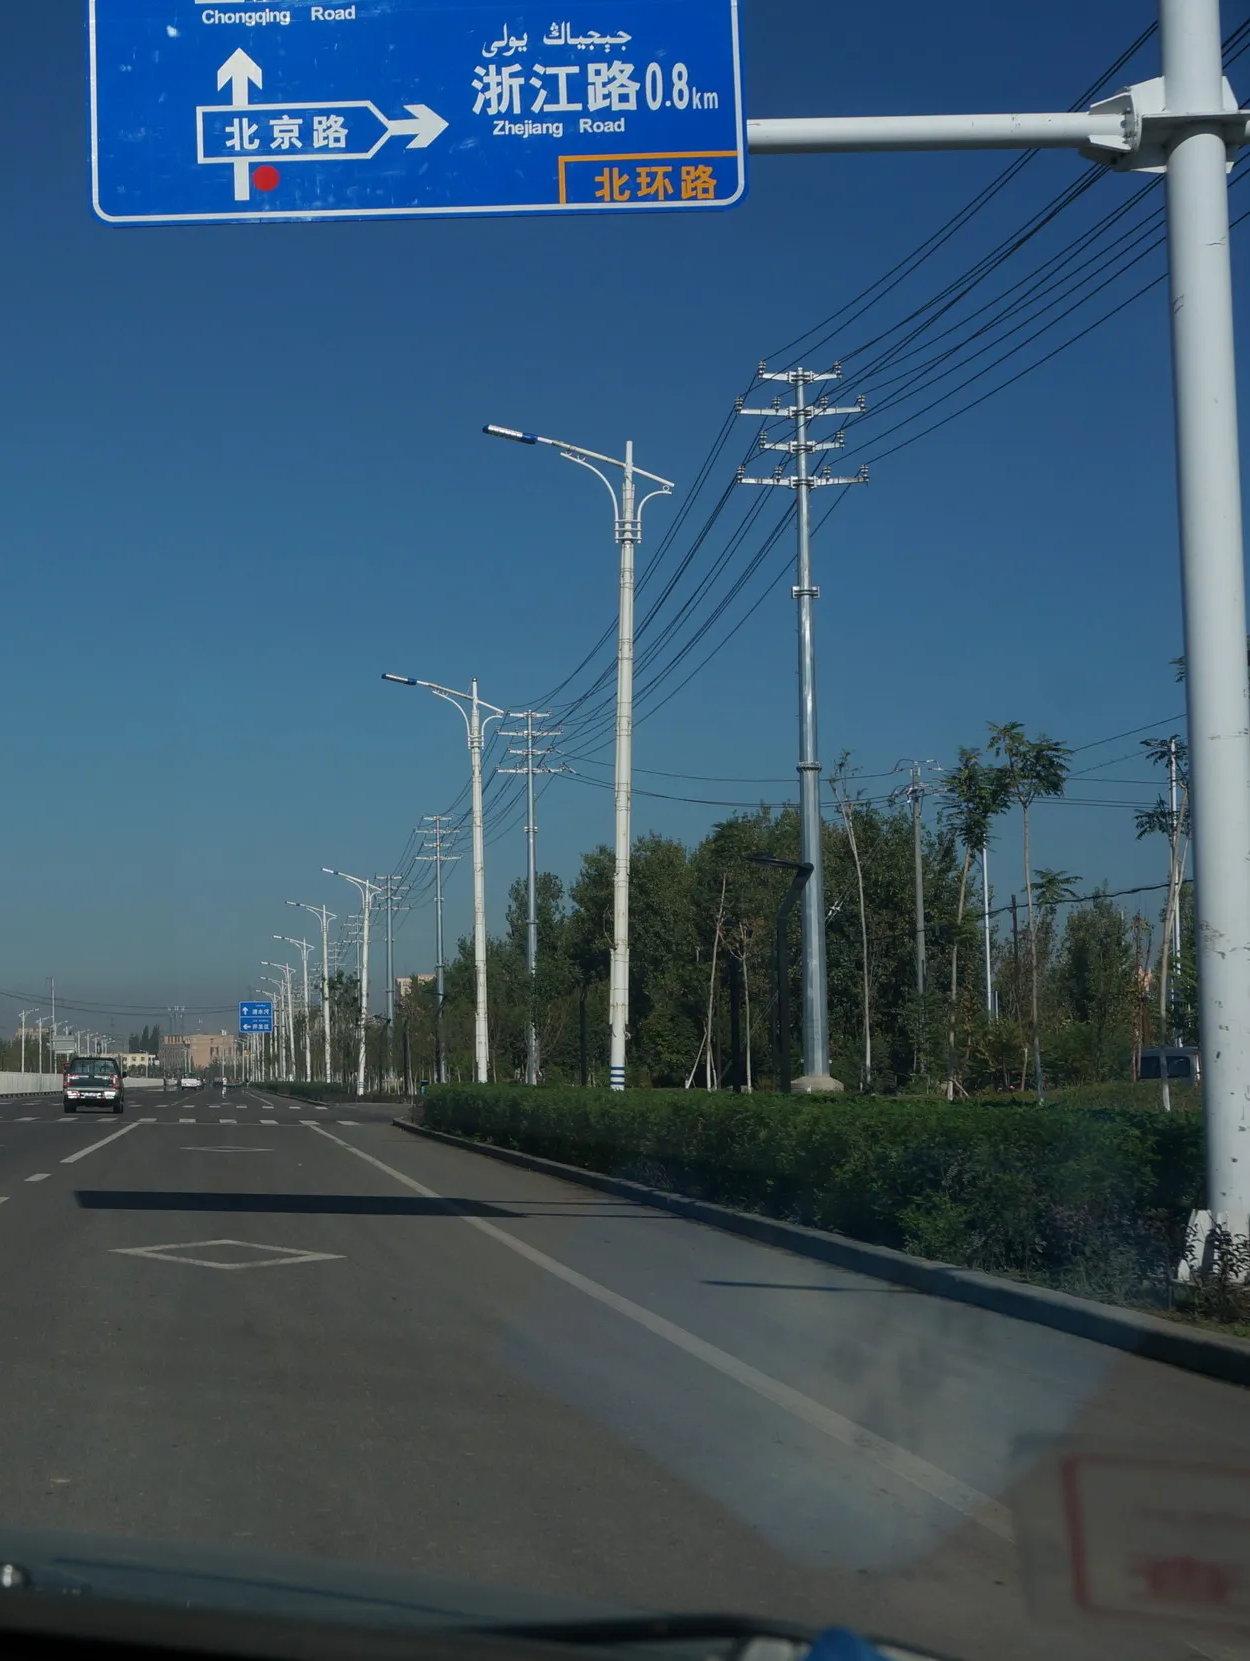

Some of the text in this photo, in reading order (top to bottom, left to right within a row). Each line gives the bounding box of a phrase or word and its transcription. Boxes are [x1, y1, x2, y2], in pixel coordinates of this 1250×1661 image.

[203, 7, 356, 27] Chongqing Road
[473, 62, 641, 115] 浙江路
[227, 116, 349, 151] 北京路
[494, 119, 625, 139] Zhejiang Road
[596, 166, 717, 201] 北环路
